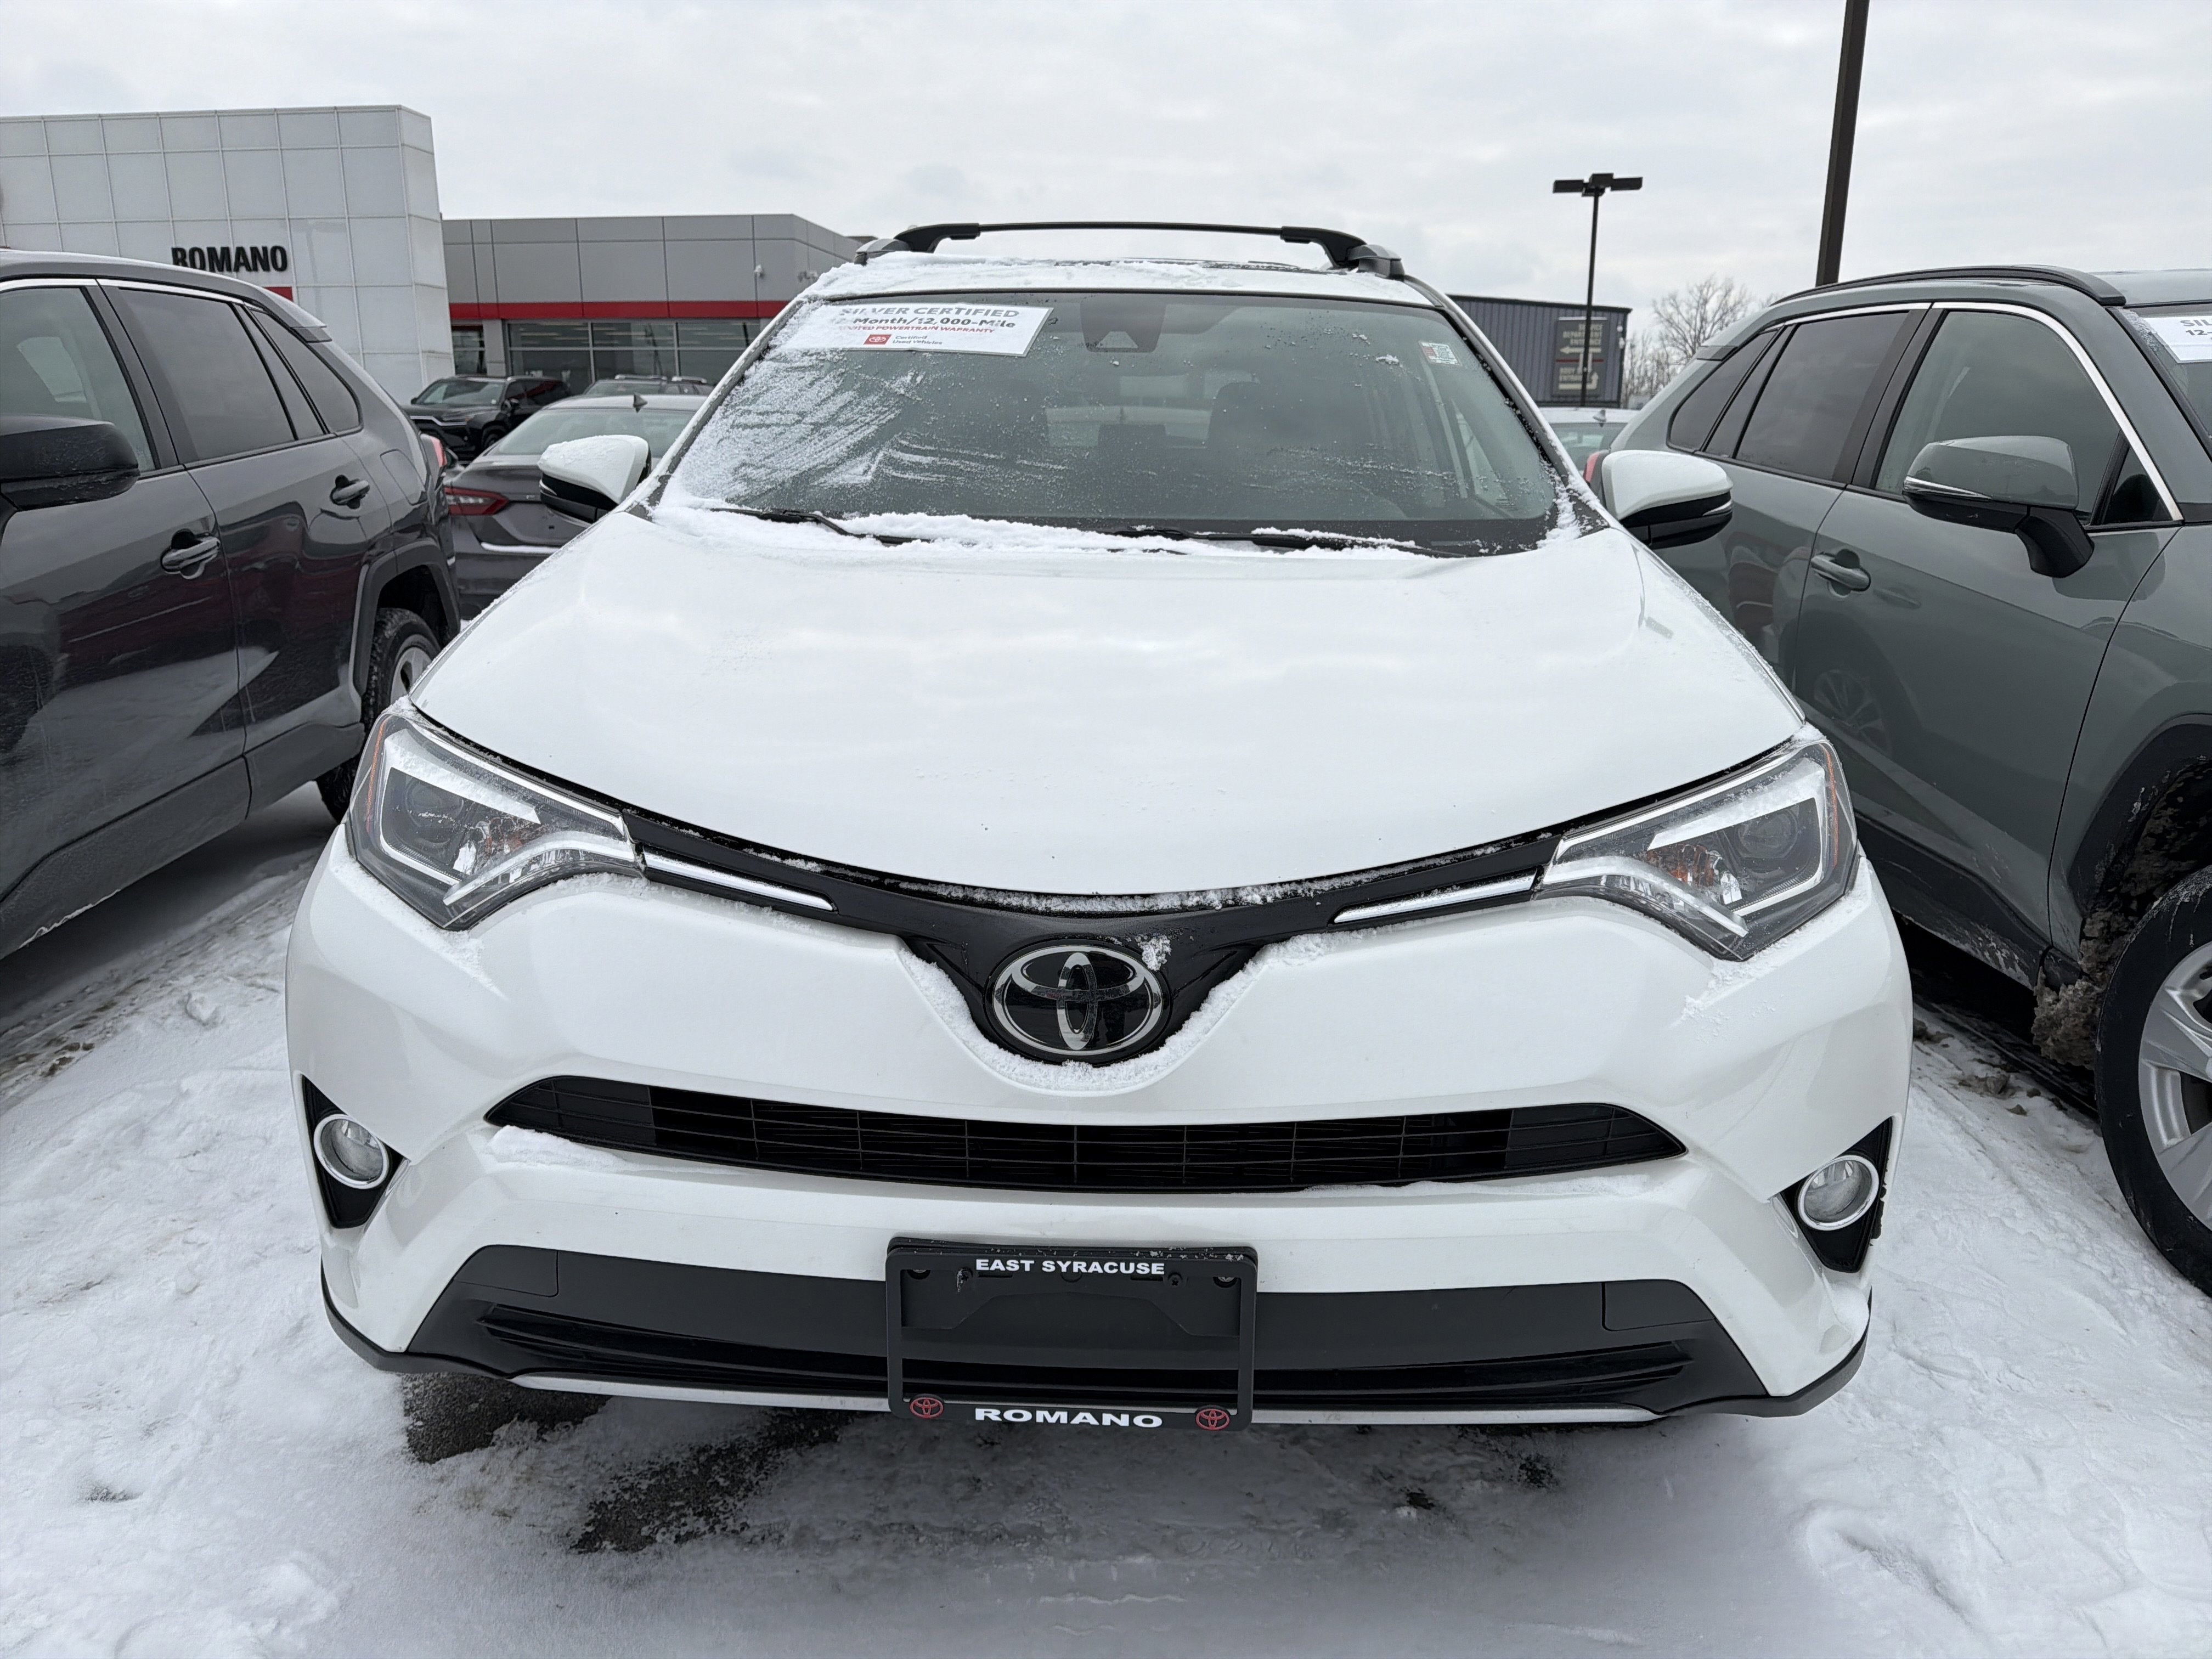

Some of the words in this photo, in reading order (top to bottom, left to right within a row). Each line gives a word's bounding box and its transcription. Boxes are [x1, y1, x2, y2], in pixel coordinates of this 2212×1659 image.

[171, 246, 287, 272] ROMANO
[913, 307, 1019, 317] CERTIFIED
[975, 1259, 1034, 1272] EAST
[1042, 1260, 1165, 1275] SYRACUSE
[975, 1408, 1163, 1428] ROMANO
